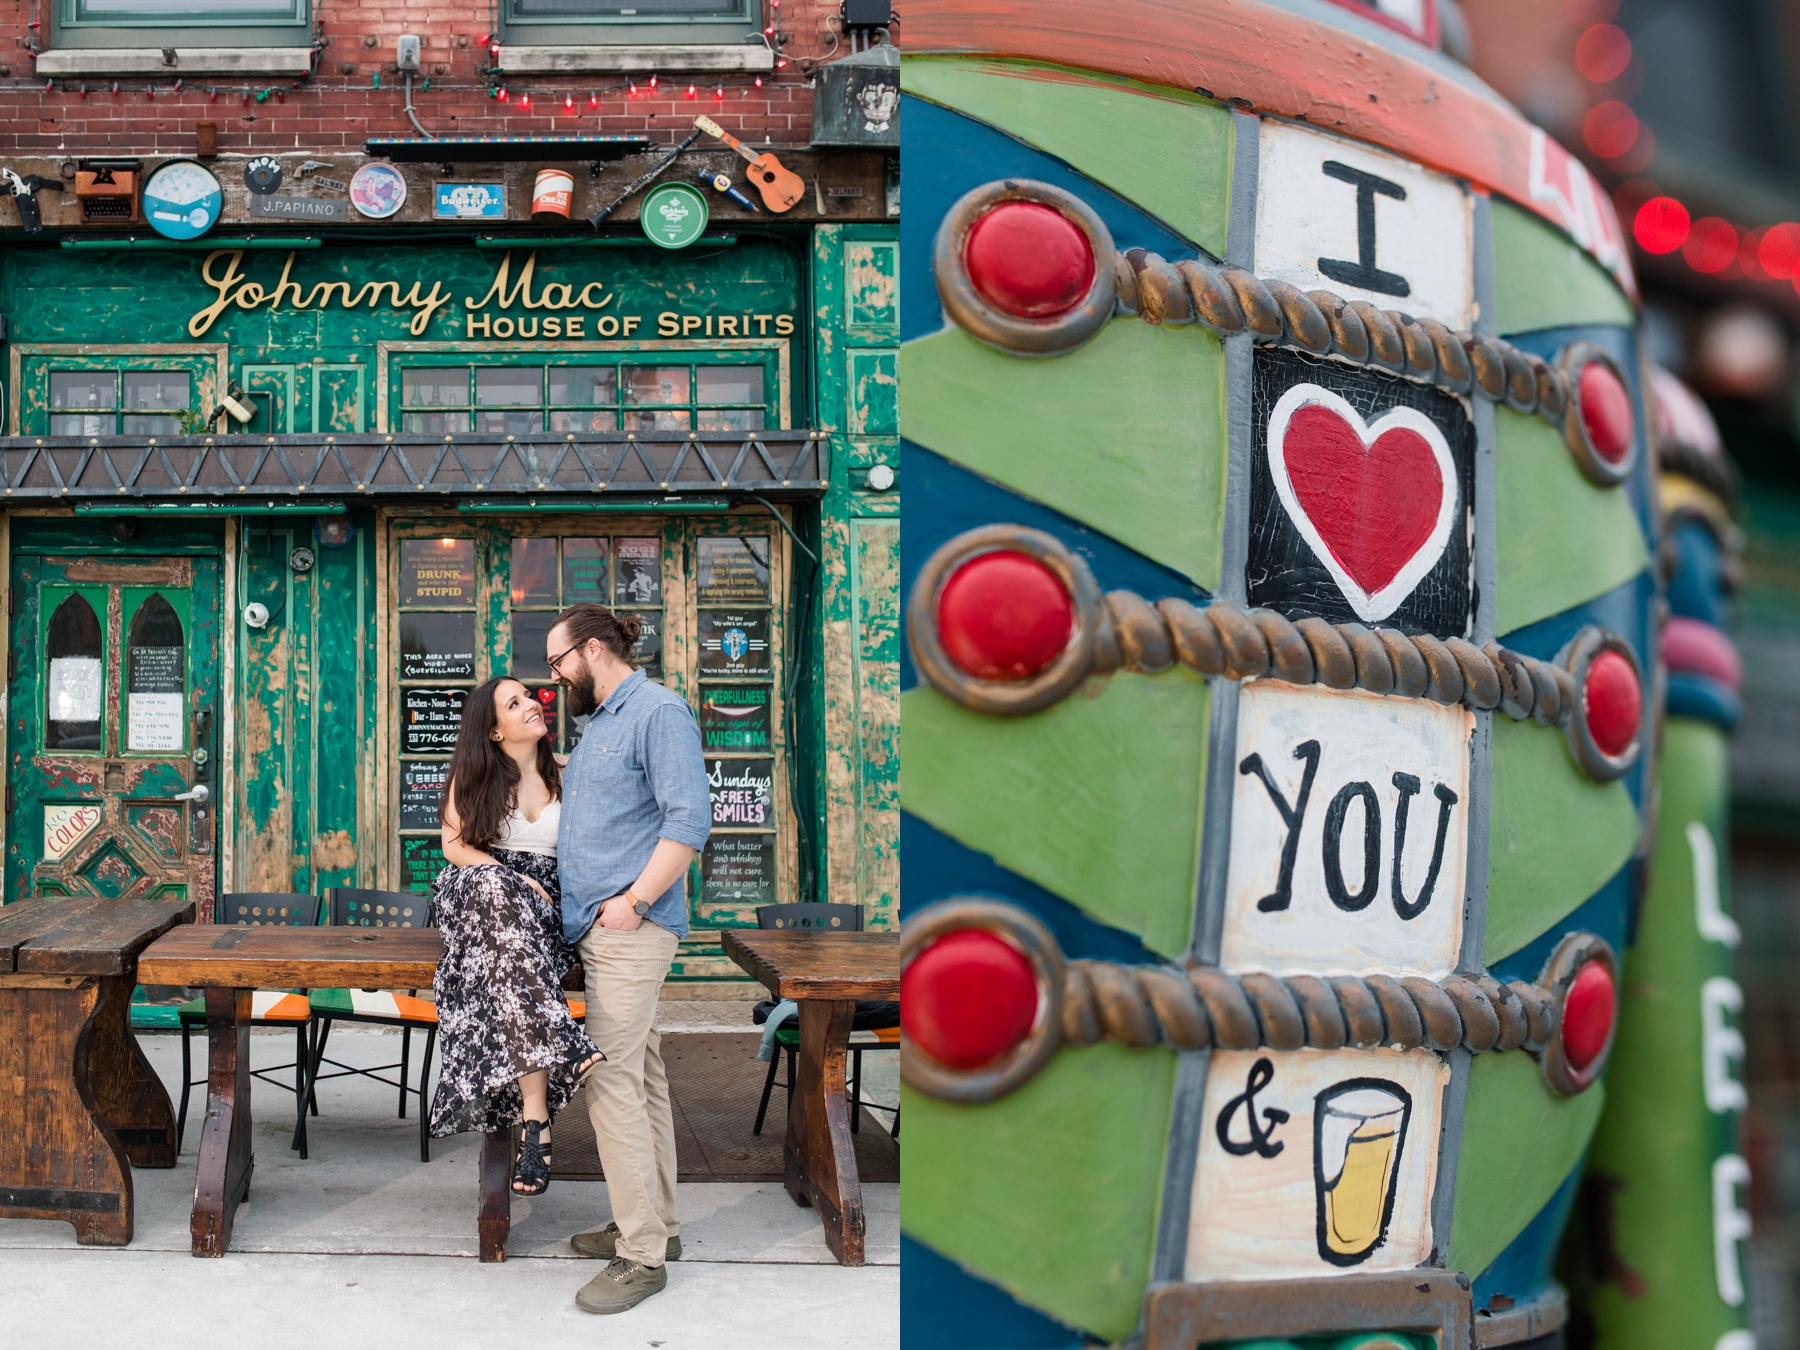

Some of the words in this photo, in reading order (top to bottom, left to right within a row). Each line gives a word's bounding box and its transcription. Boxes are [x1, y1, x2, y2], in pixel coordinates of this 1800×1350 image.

[248, 156, 281, 173] MOM
[315, 176, 344, 191] GALWAY
[540, 195, 566, 207] CREAM
[557, 191, 568, 200] ICE
[1317, 159, 1411, 298] I
[188, 249, 451, 338] Johnny
[465, 249, 614, 310] Mac
[466, 313, 586, 338] HOUSE
[597, 315, 642, 337] OF
[657, 311, 796, 337] SPIRITS
[417, 570, 461, 579] DRUNK
[417, 587, 462, 596] STUPID
[407, 698, 427, 708] Kitchen
[431, 698, 446, 707] Noon
[450, 698, 462, 708] 2am
[704, 690, 766, 704] CHEERFULLNESS
[415, 711, 425, 720] Bar
[449, 711, 462, 720] 2am
[728, 719, 749, 729] sign
[751, 718, 765, 729] of
[705, 731, 766, 746] WISDOM
[706, 760, 771, 797] Sundays
[720, 790, 753, 804] FREE
[46, 809, 68, 831] NO
[713, 803, 765, 823] SMILES
[48, 805, 98, 853] COLORS
[1239, 739, 1458, 921] YOU
[713, 840, 735, 851] What
[737, 840, 762, 850] butter
[407, 861, 426, 869] THERE
[429, 861, 435, 869] IS
[713, 854, 729, 863] and
[730, 852, 762, 865] whiskey
[412, 872, 428, 880] THAT
[712, 864, 728, 875] will
[706, 876, 724, 888] there
[725, 879, 731, 888] is
[759, 877, 769, 889] for
[1216, 1057, 1290, 1159] &
